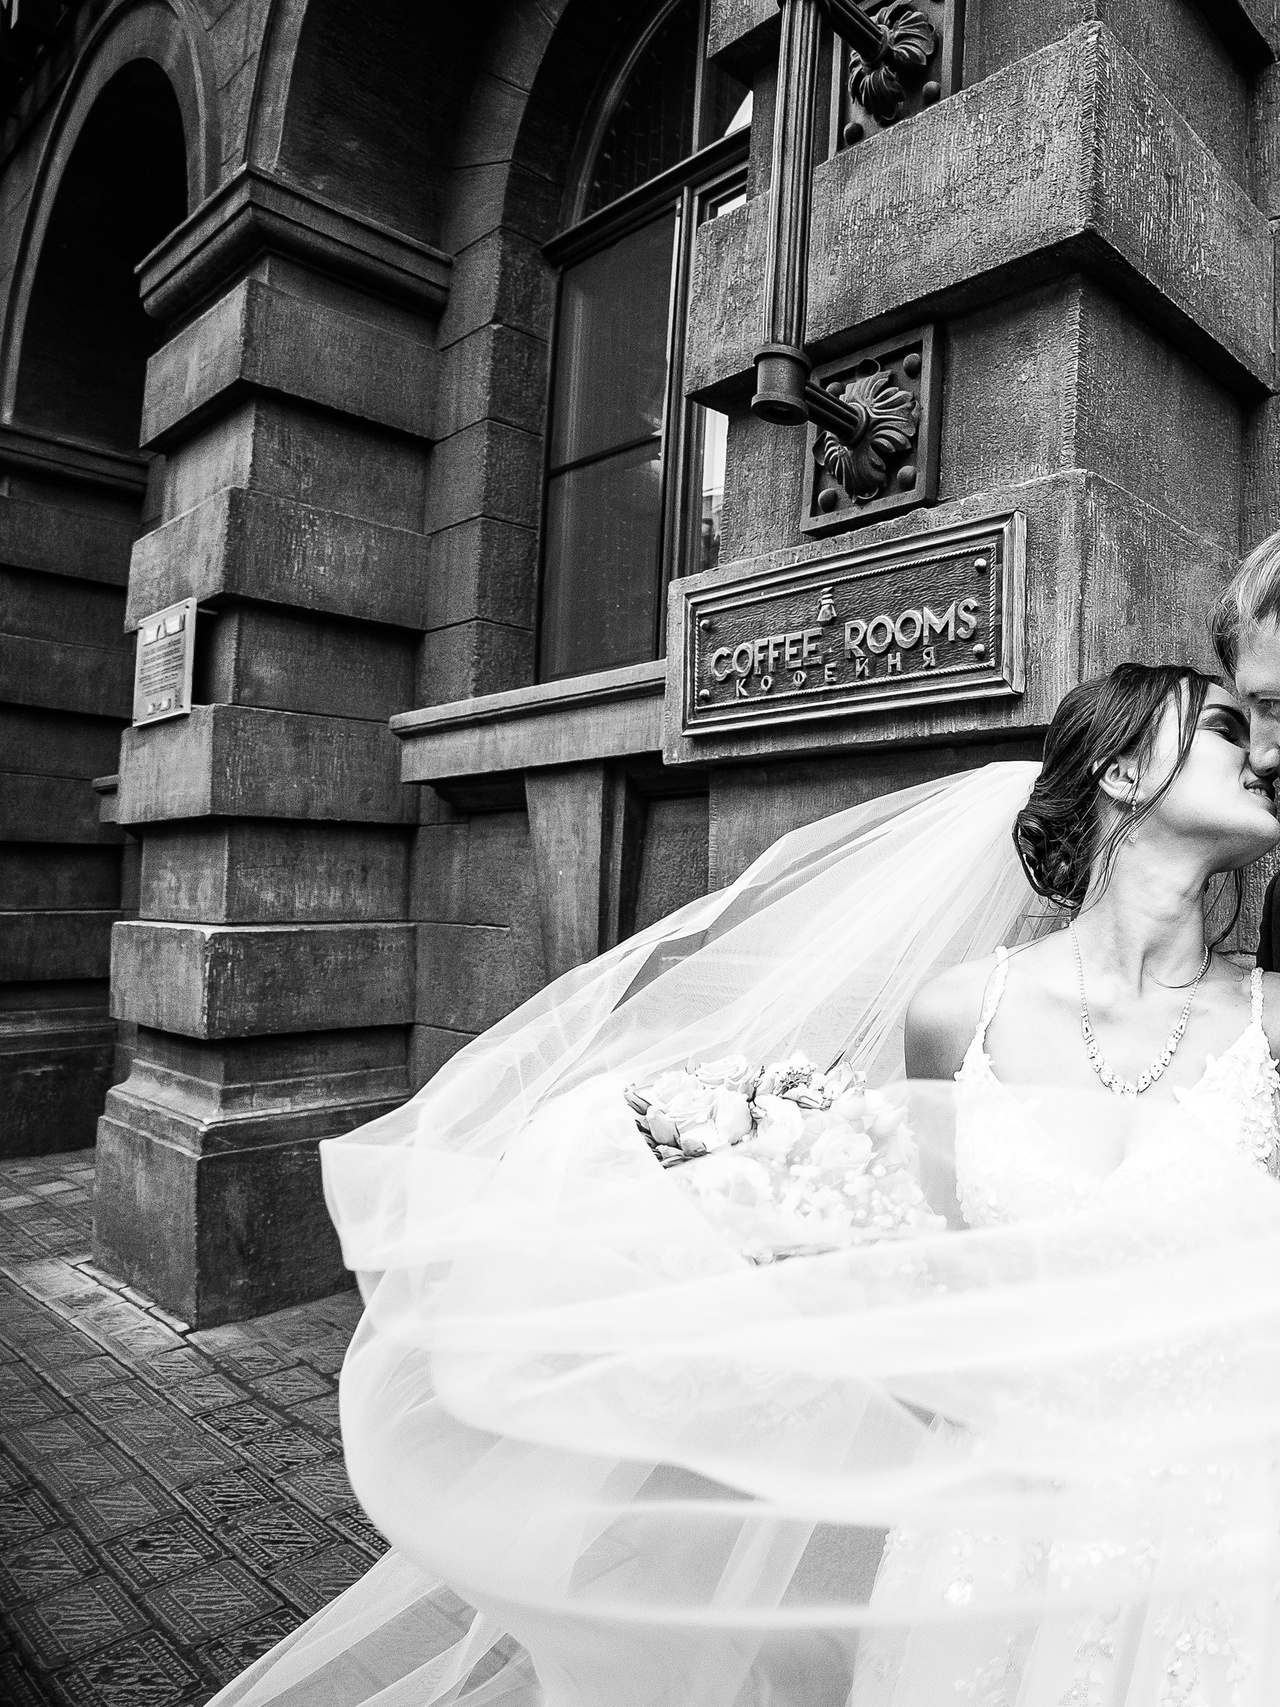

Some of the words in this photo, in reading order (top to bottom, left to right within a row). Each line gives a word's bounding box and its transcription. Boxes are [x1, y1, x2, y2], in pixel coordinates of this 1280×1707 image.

[710, 627, 824, 682] COFFEE
[844, 598, 979, 659] ROOMS
[736, 646, 936, 698] КОФЕЙНЯ
